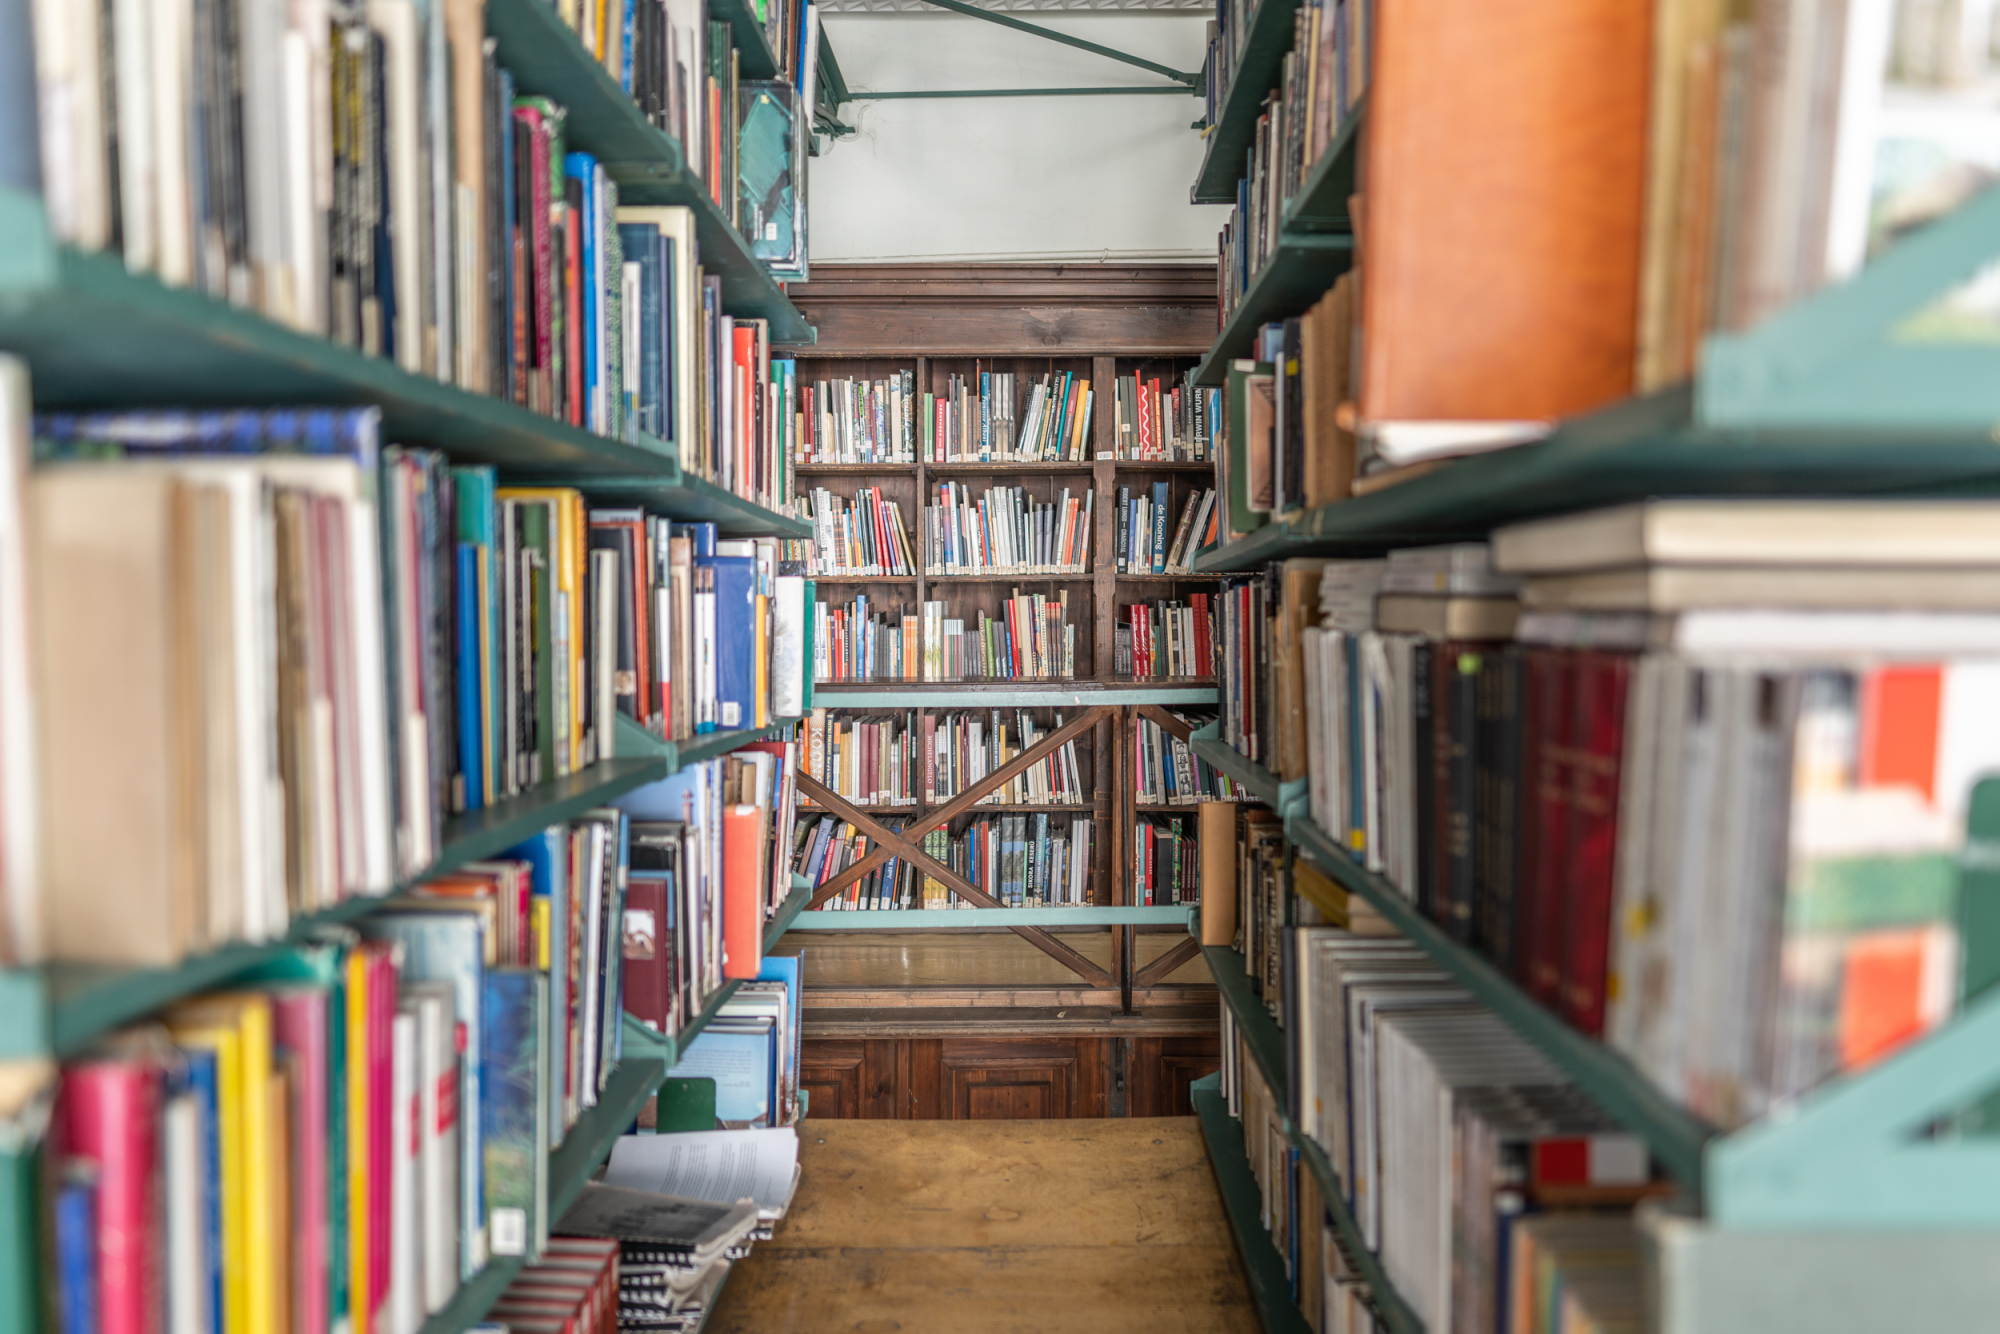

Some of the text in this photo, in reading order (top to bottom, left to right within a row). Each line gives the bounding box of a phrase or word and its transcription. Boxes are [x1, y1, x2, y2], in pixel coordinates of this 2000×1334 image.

[981, 395, 989, 421] Francesco
[1155, 504, 1165, 550] de Kooning
[810, 727, 823, 782] KOONS
[886, 867, 894, 879] Judit
